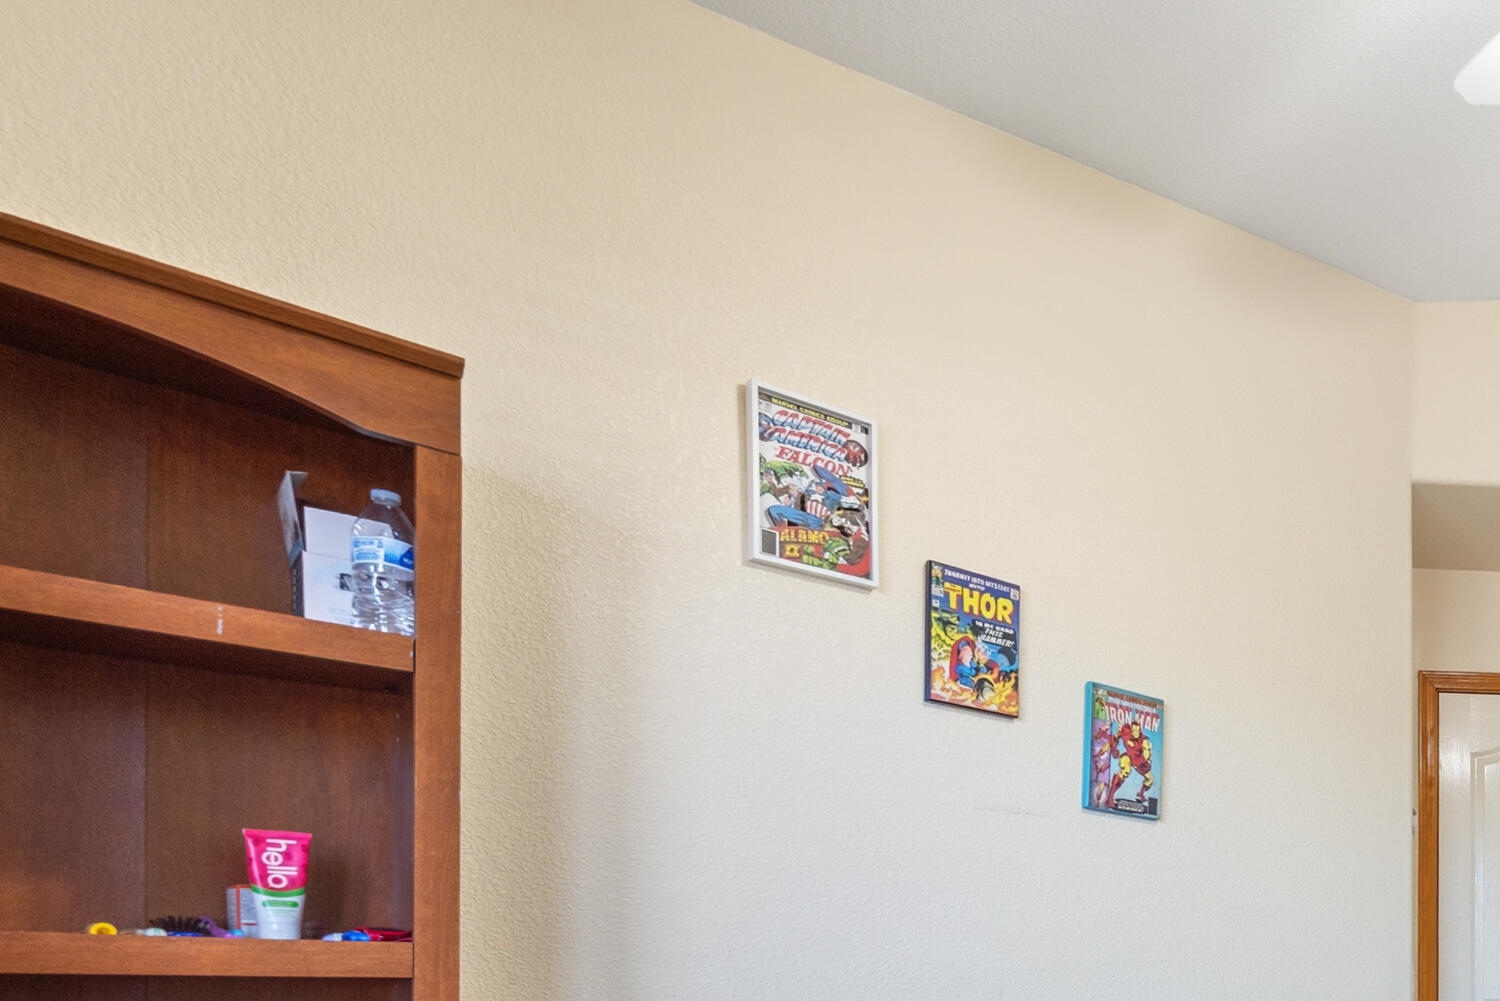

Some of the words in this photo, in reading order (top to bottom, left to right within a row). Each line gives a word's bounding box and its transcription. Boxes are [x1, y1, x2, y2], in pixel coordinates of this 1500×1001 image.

[768, 427, 848, 462] AMERICA
[772, 410, 851, 446] CAPTAIN
[775, 445, 852, 477] FALCON
[780, 528, 830, 545] ALAMO
[943, 582, 1014, 625] THOR
[1105, 702, 1132, 725] IRON
[1135, 708, 1161, 733] MAN
[261, 838, 298, 889] hello
